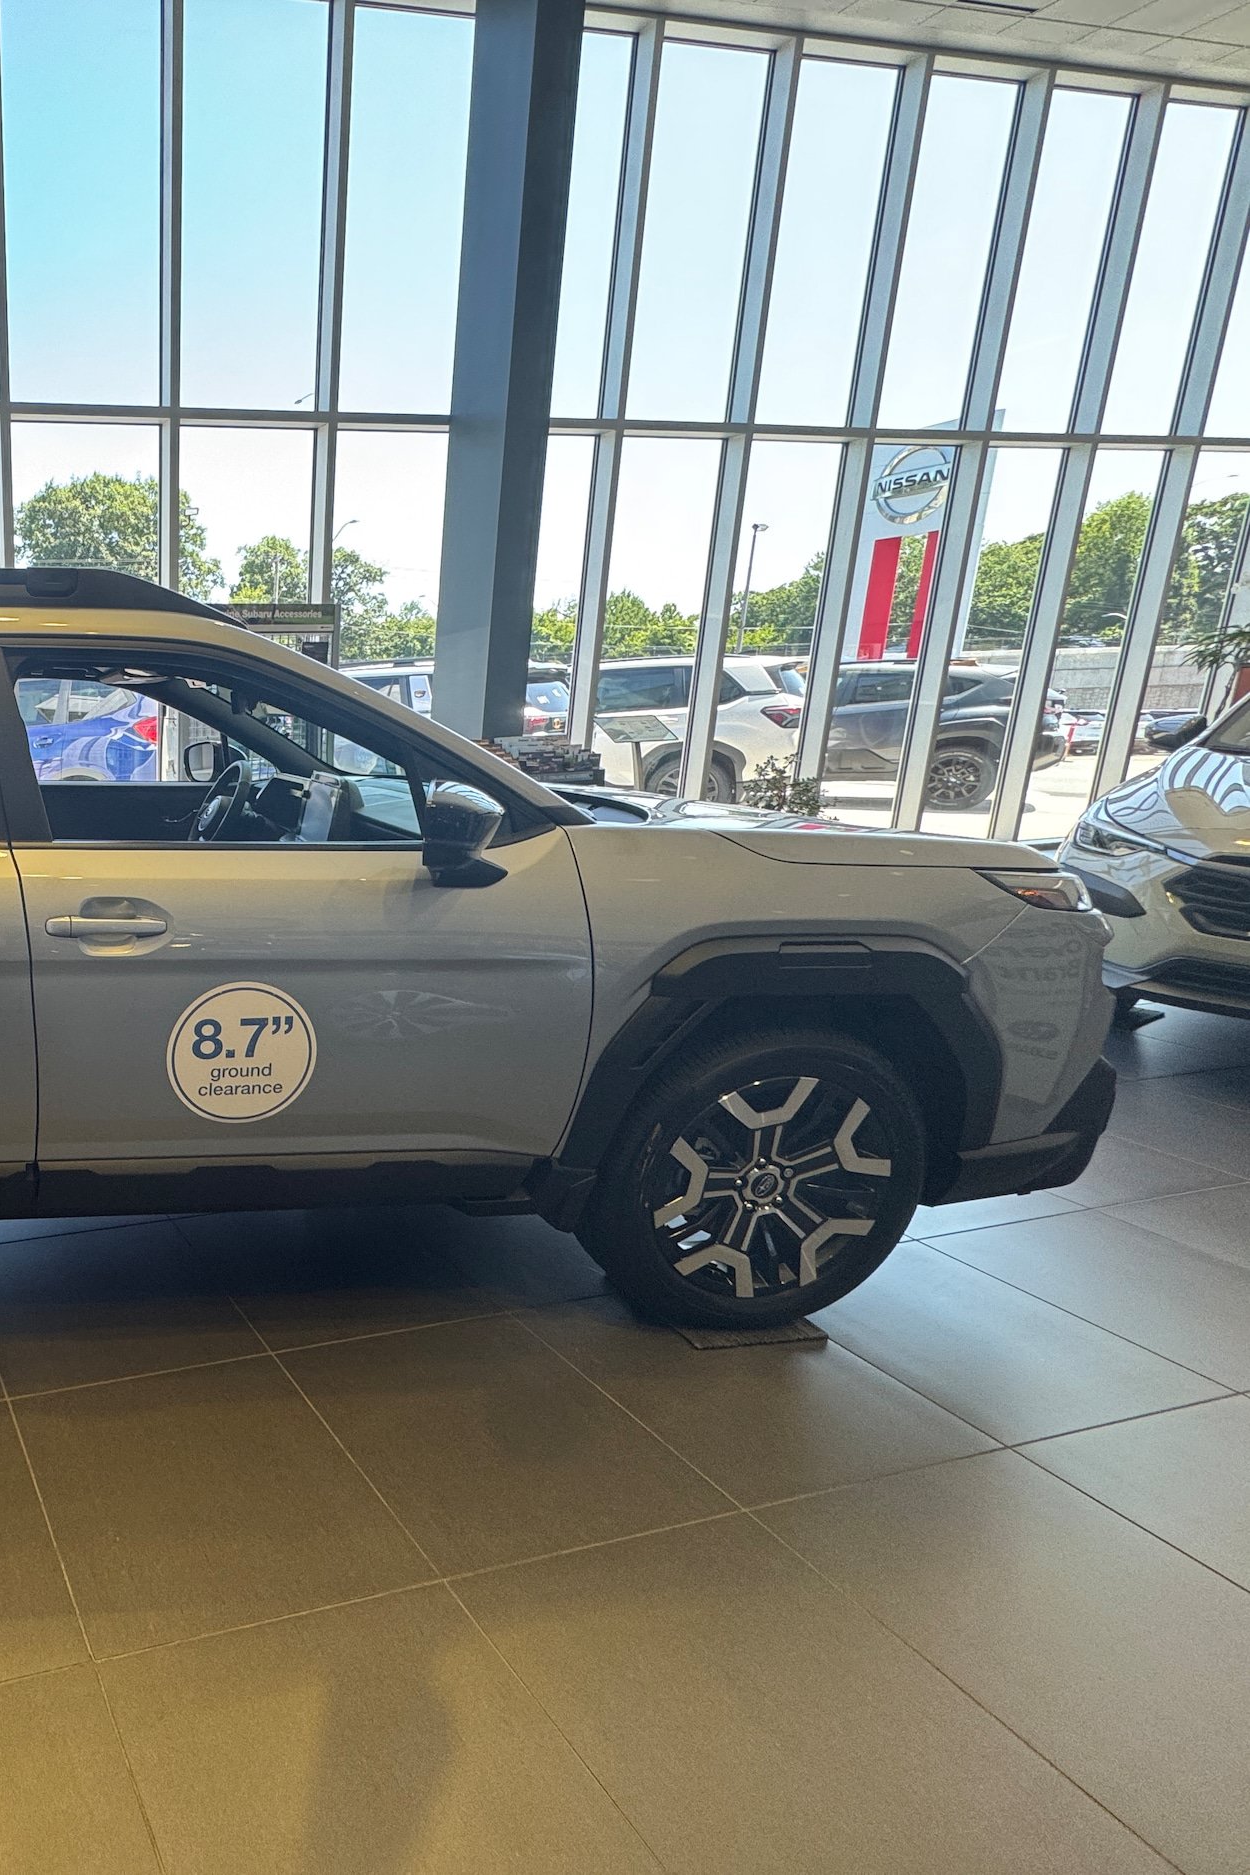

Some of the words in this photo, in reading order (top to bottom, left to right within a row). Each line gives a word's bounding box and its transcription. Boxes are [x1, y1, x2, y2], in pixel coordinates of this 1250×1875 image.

[877, 467, 950, 493] NISSAN
[242, 609, 272, 618] Subaru
[273, 608, 323, 618] Accessories
[210, 1062, 273, 1082] ground
[198, 1082, 284, 1097] clearance
